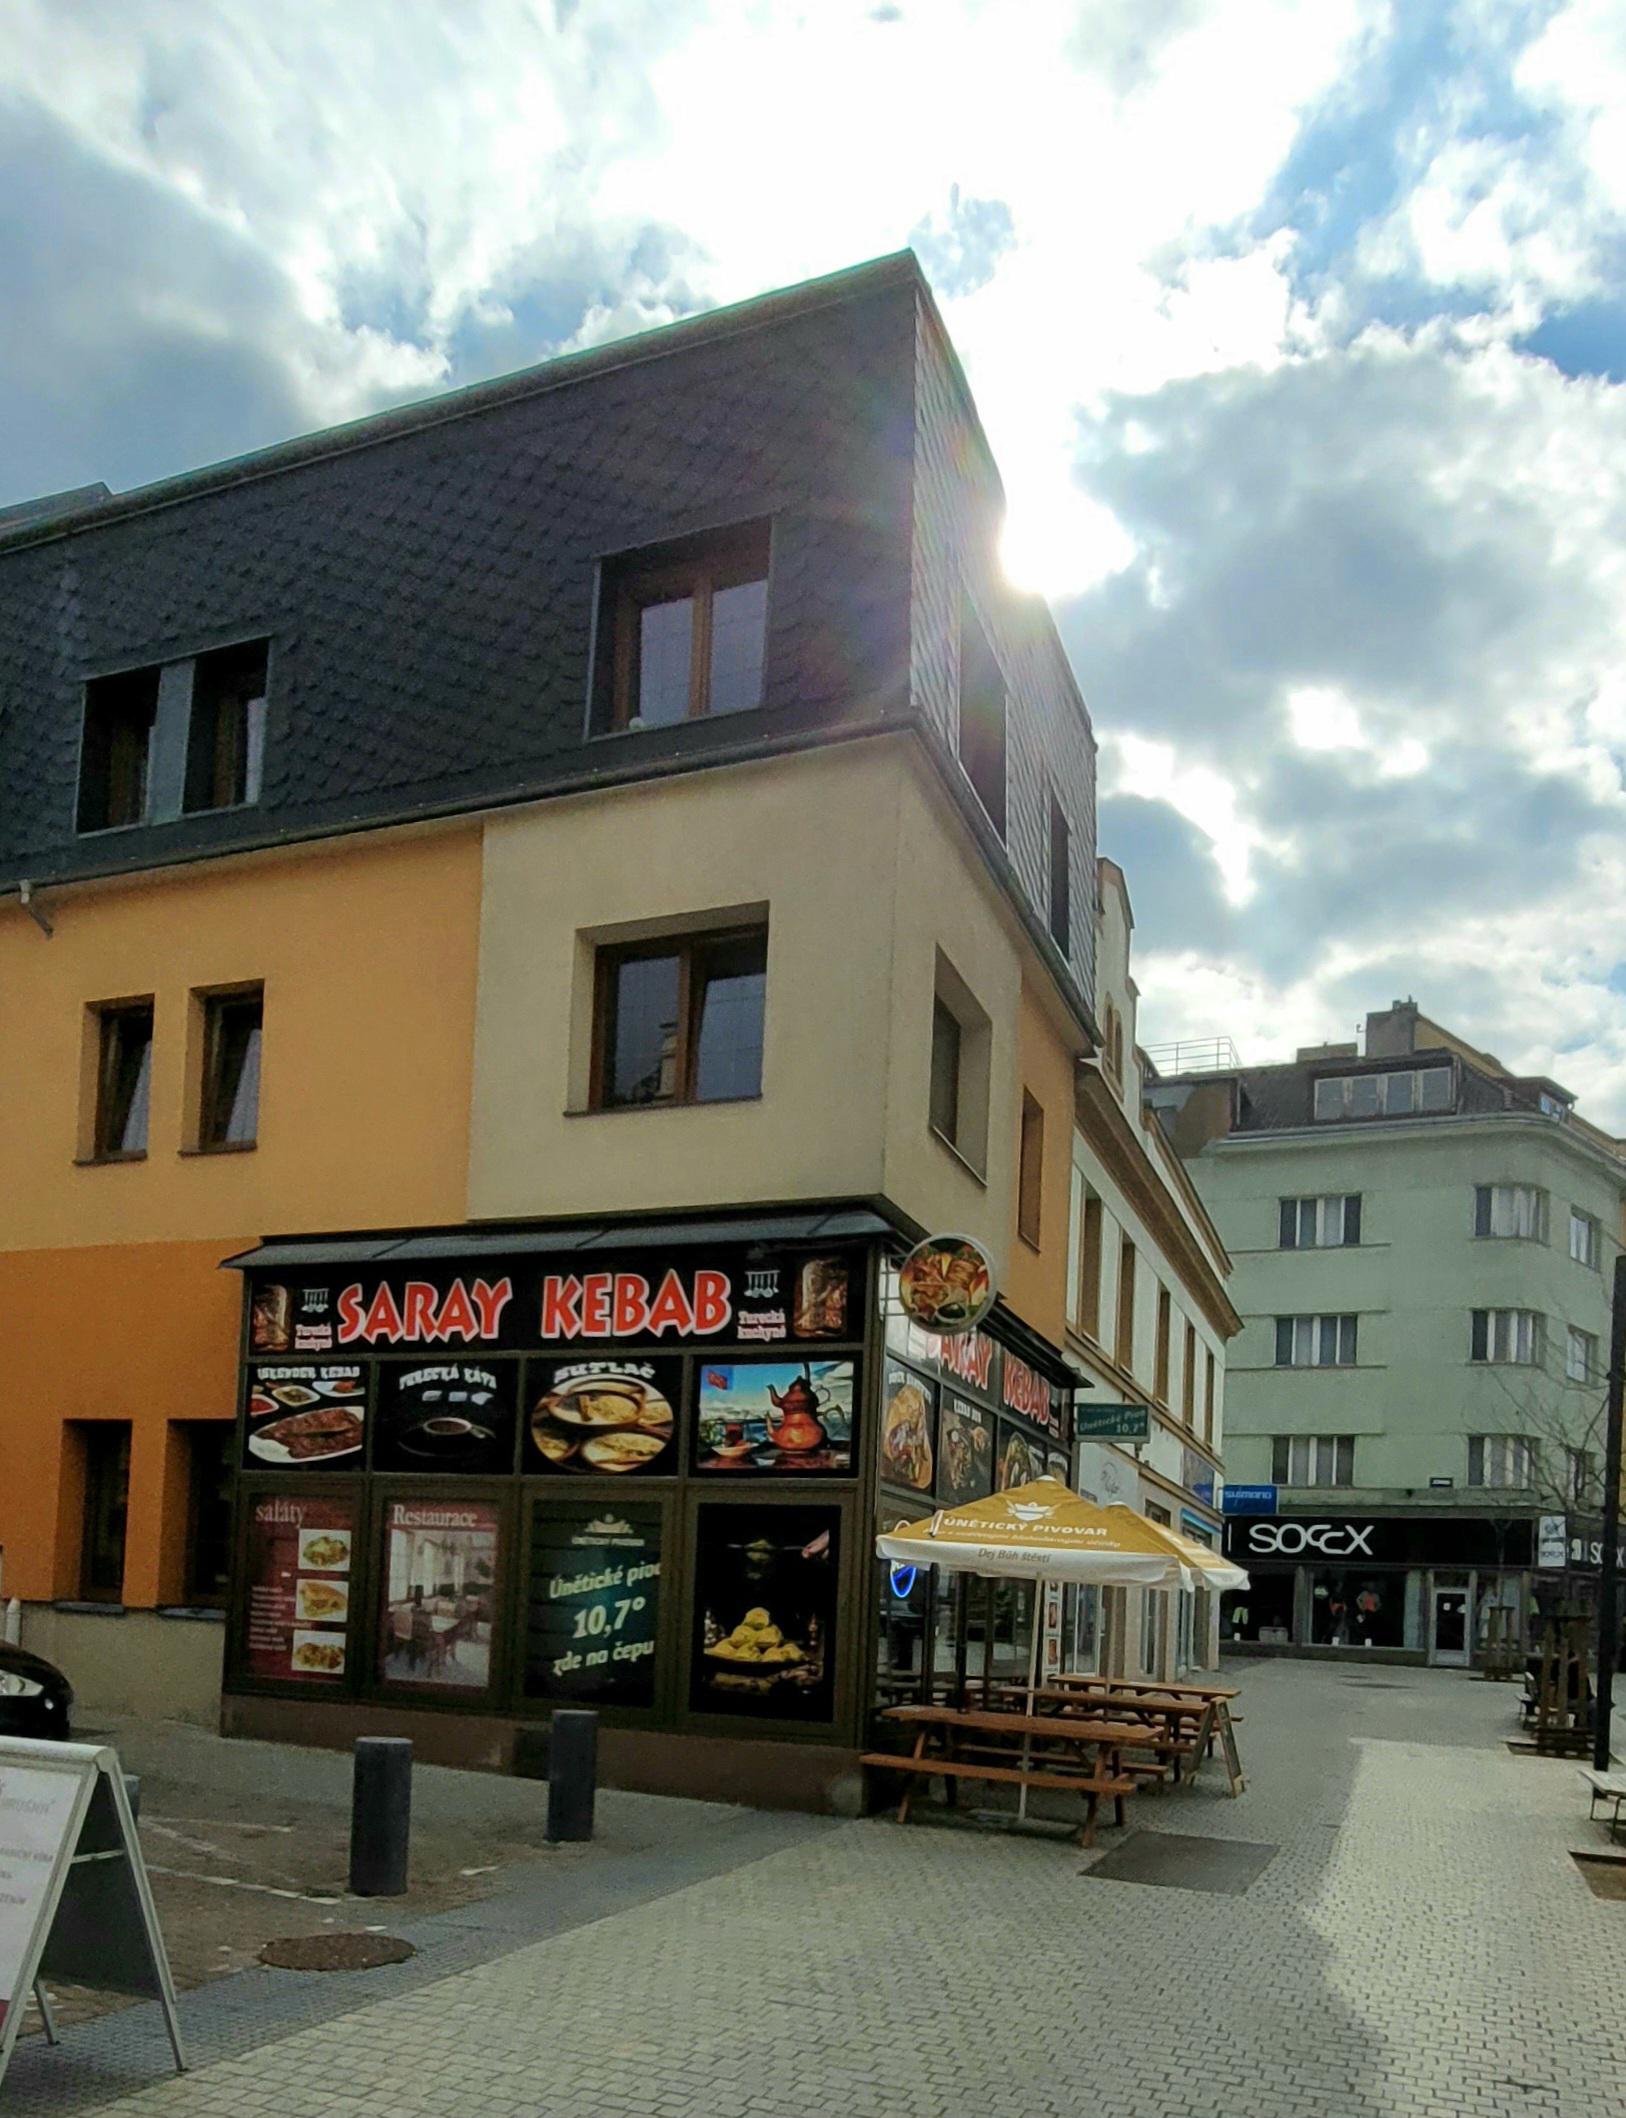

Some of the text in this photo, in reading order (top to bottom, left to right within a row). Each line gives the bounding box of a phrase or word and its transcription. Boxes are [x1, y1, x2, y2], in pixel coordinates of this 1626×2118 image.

[337, 1268, 732, 1344] SARAY KEBAB
[393, 1504, 478, 1527] Restaurace
[1032, 1525, 1108, 1537] PIVOVAR
[1249, 1523, 1375, 1555] SOCCX
[586, 1650, 608, 1667] na
[612, 1640, 655, 1663] čepu
